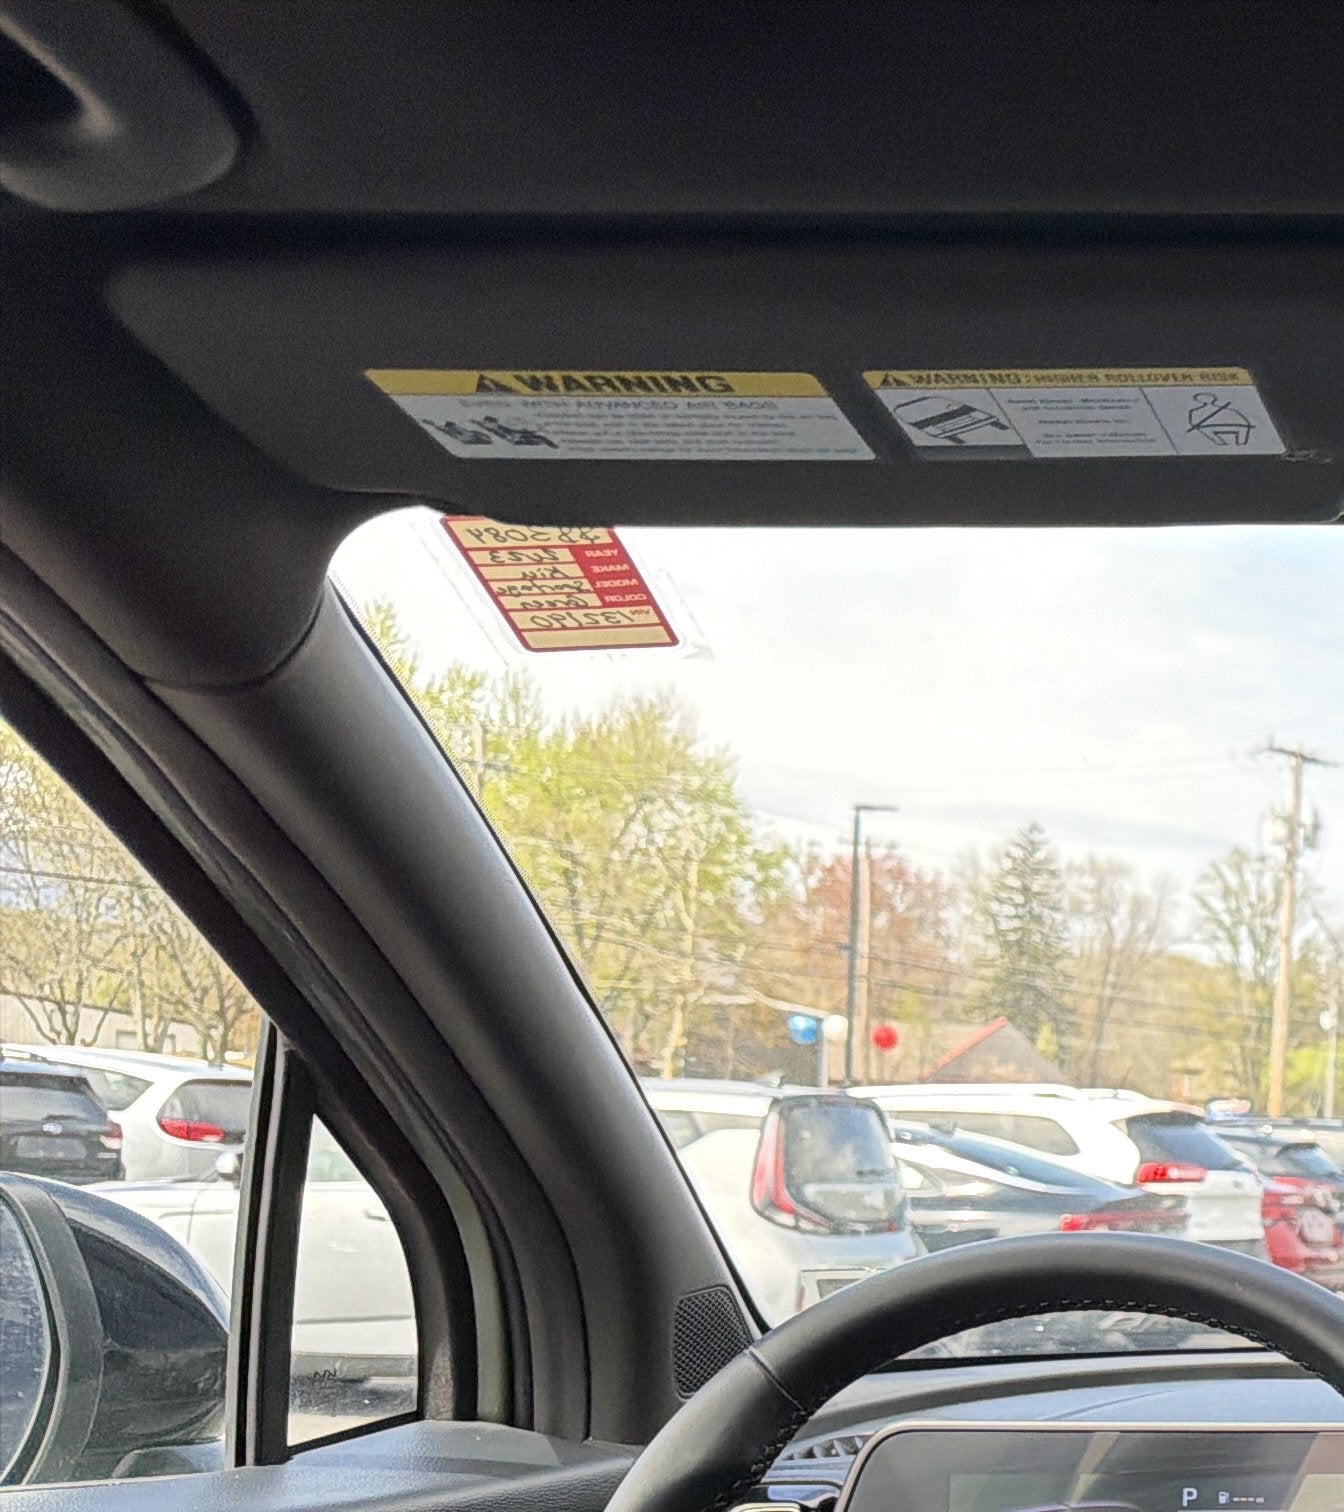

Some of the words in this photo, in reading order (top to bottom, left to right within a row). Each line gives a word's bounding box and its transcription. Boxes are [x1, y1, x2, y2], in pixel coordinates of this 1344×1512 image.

[512, 373, 735, 393] WARNING
[1104, 373, 1193, 383] ROLLOVER
[1200, 372, 1239, 382] RISK
[1182, 1487, 1198, 1507] P
